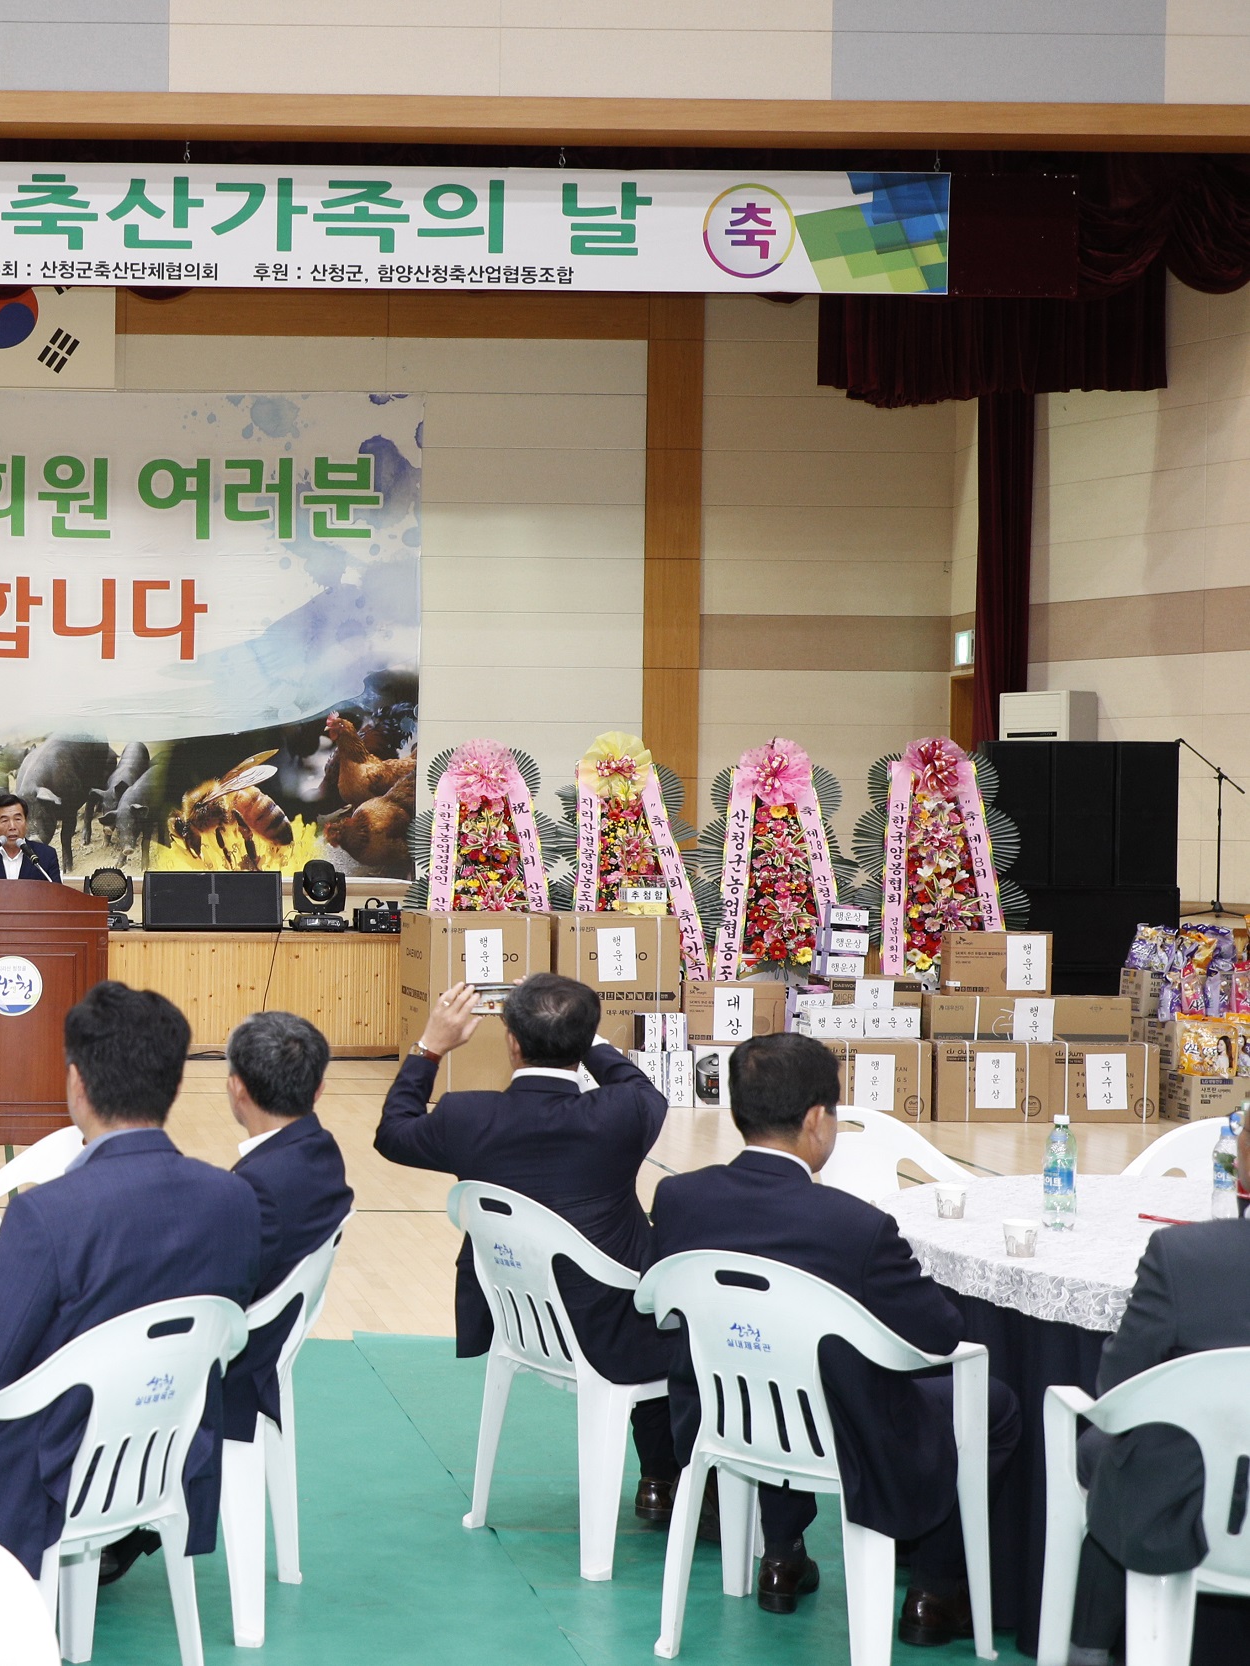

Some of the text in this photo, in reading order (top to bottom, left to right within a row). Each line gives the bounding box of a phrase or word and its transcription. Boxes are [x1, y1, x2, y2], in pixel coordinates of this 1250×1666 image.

[561, 181, 653, 257] 날
[724, 201, 778, 260] 축
[39, 260, 220, 282] 산청군축산단체협의회
[252, 263, 290, 283] 후원
[308, 263, 370, 285] 산청군,
[376, 264, 575, 285] 함양산청축산업협동조합
[137, 456, 382, 541] 여러분
[512, 801, 530, 815] 祝
[527, 881, 545, 911] 산청
[660, 845, 684, 890] 제18회
[630, 888, 665, 901] 추첨함
[835, 911, 862, 921] 행운상
[479, 935, 491, 978] 행운상
[612, 935, 624, 977] 행운상
[836, 938, 862, 949] 행운상
[1022, 943, 1033, 986] 행운상
[831, 962, 857, 973] 행운상
[726, 994, 743, 1036] 대상
[818, 1017, 858, 1028] 행운상
[871, 1017, 913, 1028] 행운상
[674, 1060, 685, 1102] 장려상
[870, 1060, 880, 1102] 행운상
[991, 1058, 1001, 1100] 행운상
[1101, 1060, 1114, 1105] 우수상
[1043, 1177, 1062, 1188] 이트
